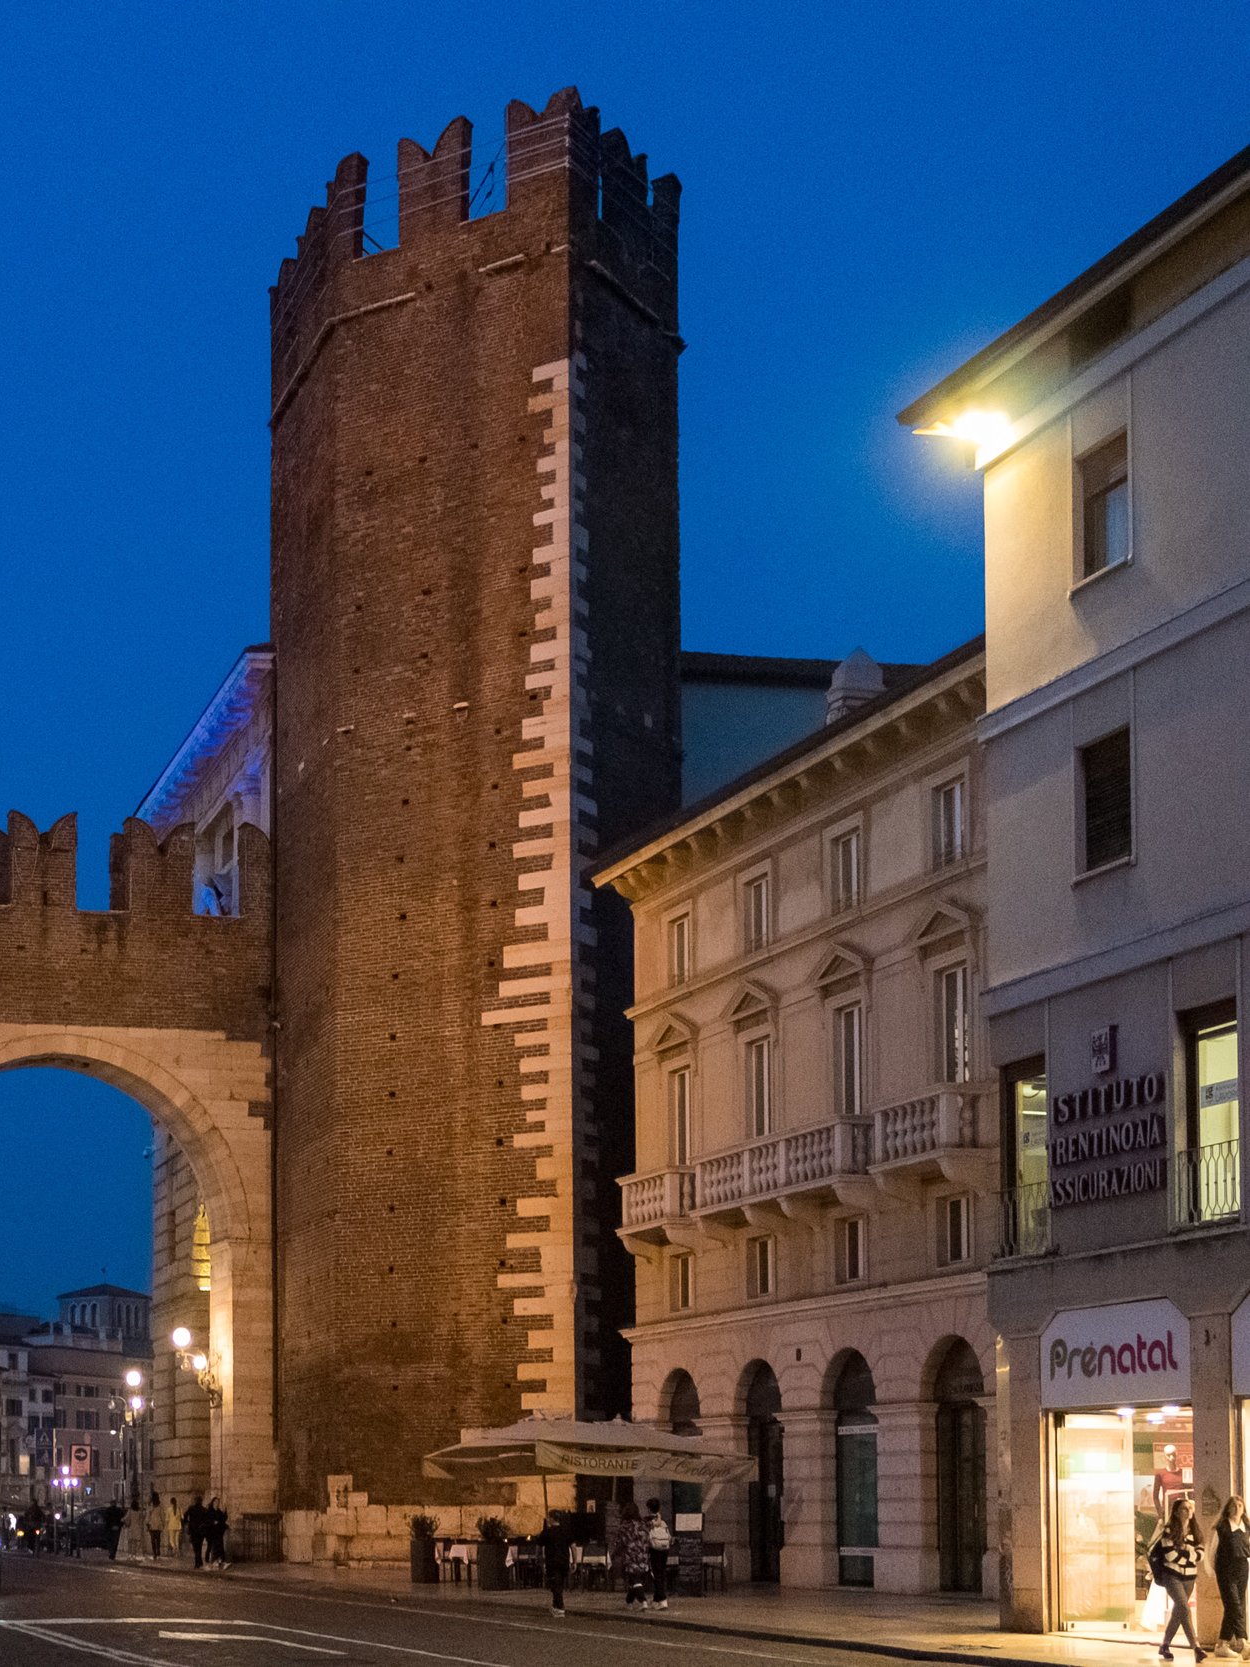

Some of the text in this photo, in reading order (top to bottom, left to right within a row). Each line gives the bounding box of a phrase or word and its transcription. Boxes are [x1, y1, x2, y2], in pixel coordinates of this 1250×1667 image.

[1050, 1073, 1157, 1123] ISTITUTO
[1049, 1160, 1161, 1208] ASSICURAZIONI
[560, 1454, 639, 1470] RISTORANTE
